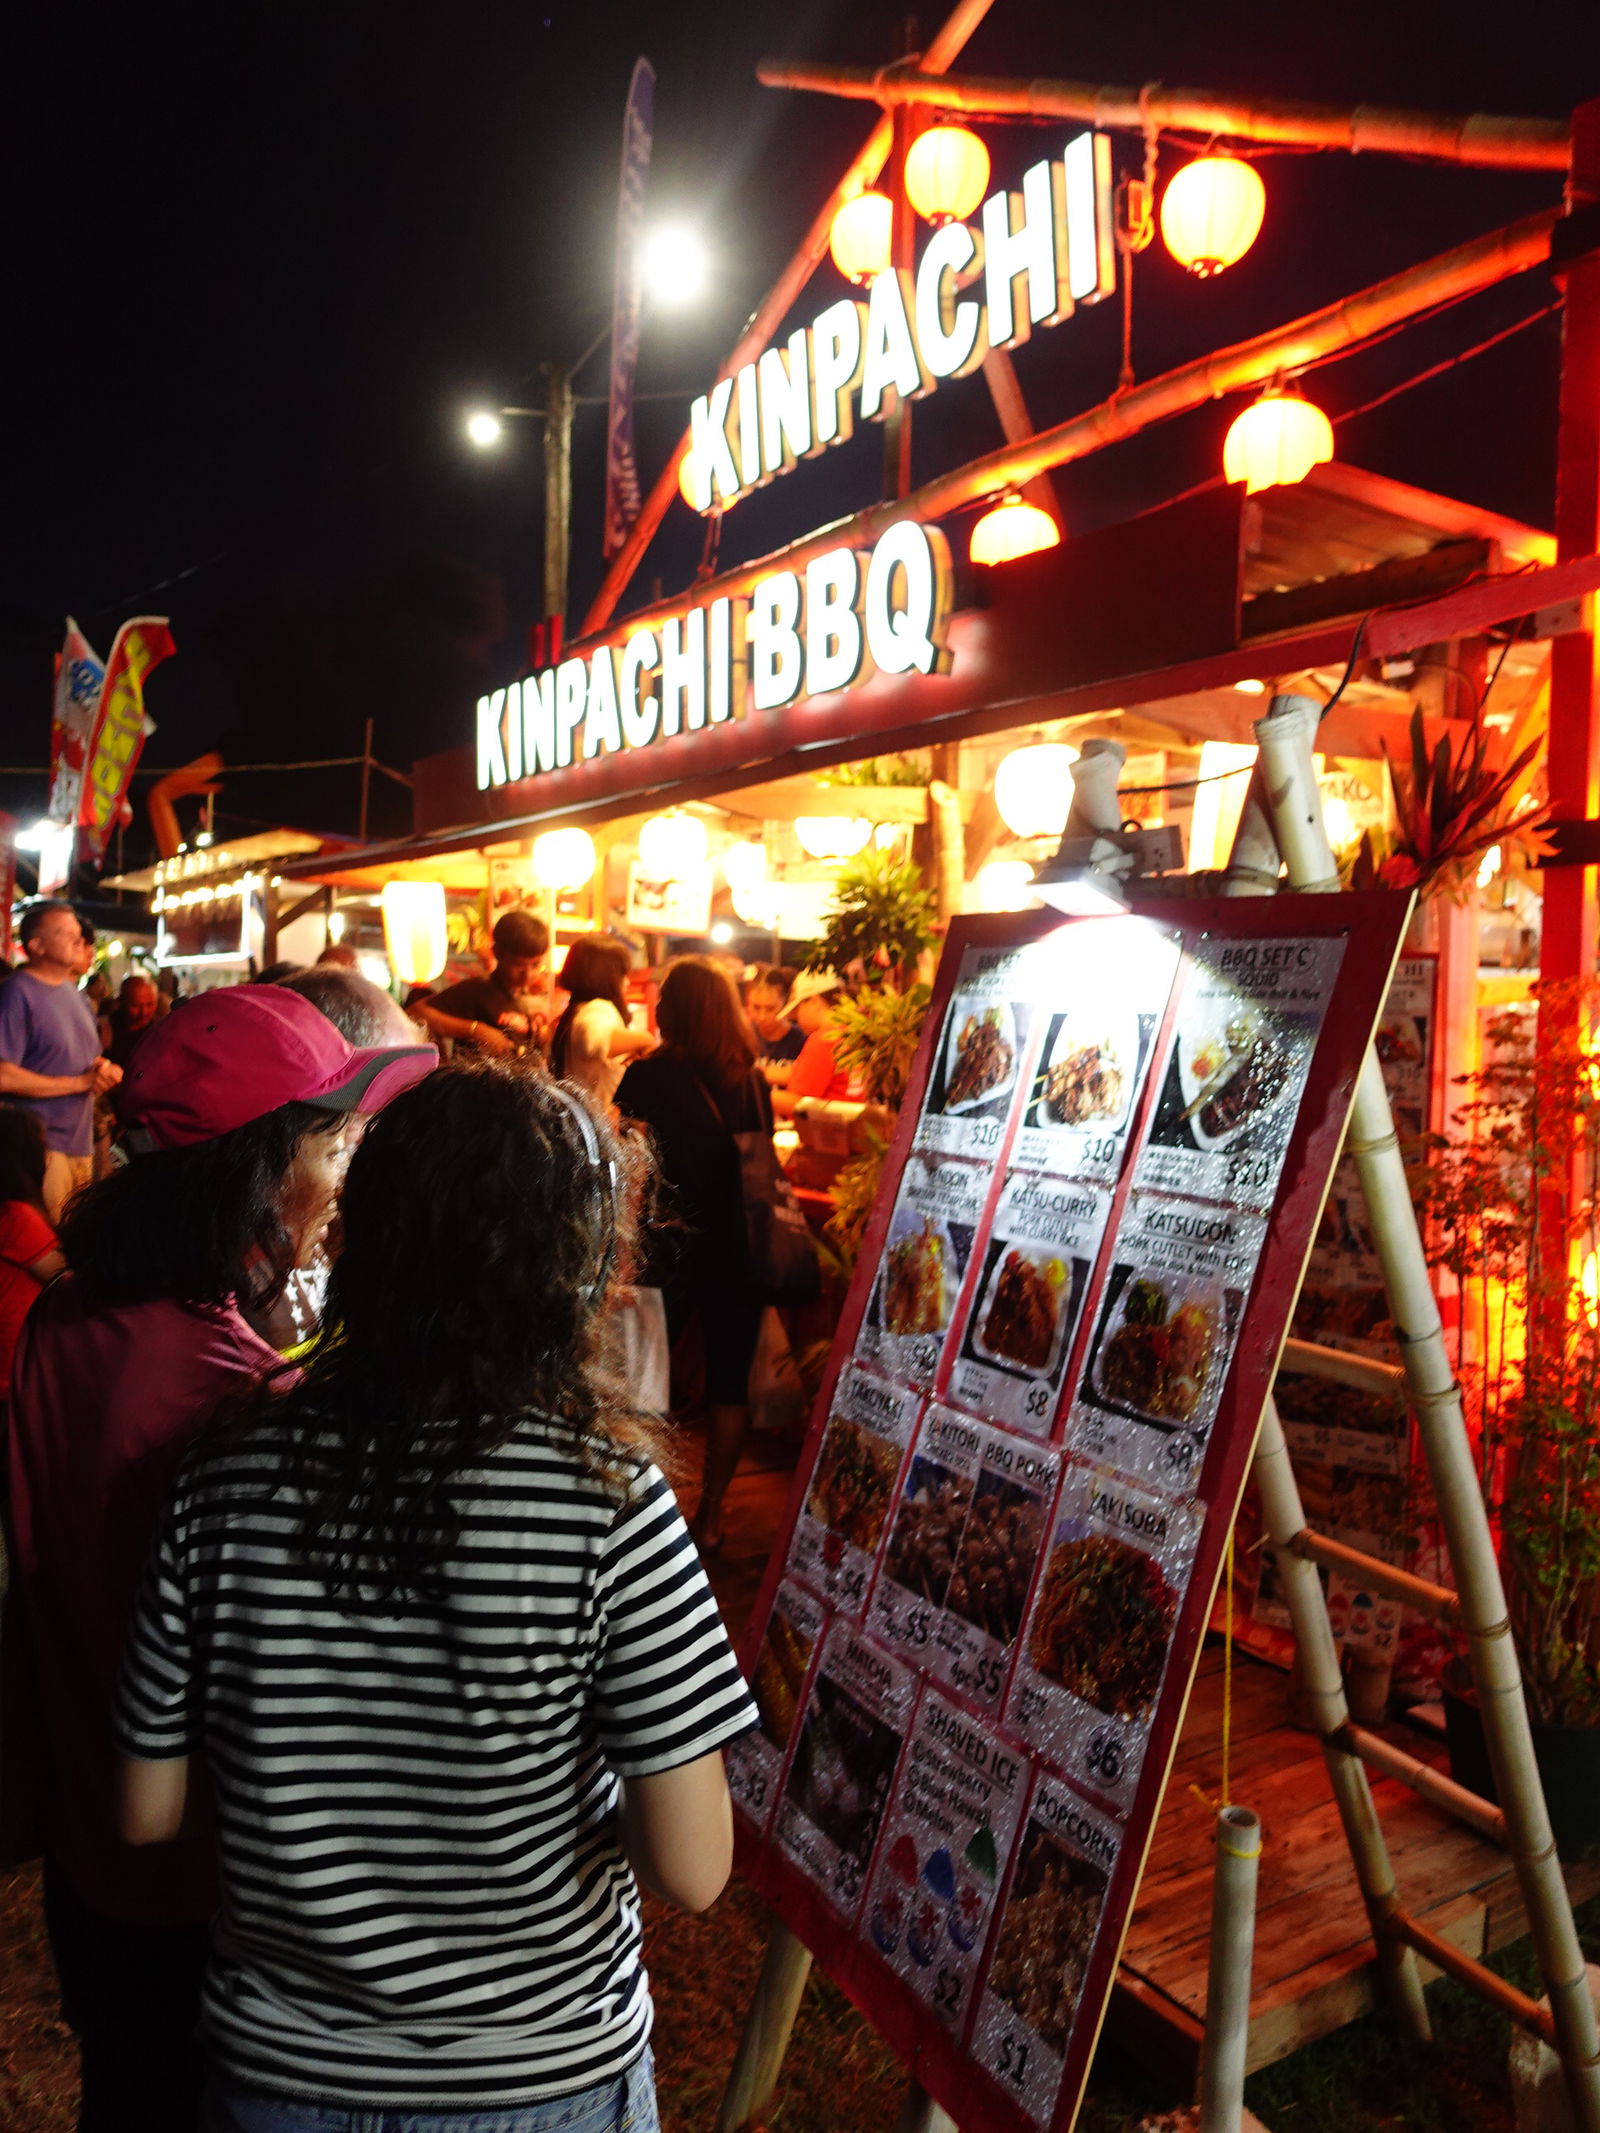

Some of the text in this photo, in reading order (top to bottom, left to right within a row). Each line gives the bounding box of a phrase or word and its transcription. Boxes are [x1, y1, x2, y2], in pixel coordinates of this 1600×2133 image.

[690, 131, 1112, 514] KINPACHI
[475, 519, 948, 791] KINPACHI BBQ
[1220, 945, 1312, 970] BBQ SET C
[970, 1121, 1001, 1146] $10
[1081, 1137, 1116, 1163] $10
[1009, 1186, 1098, 1220] KATSU-CURRY
[1144, 1208, 1239, 1245] KATSUDON
[1151, 1237, 1192, 1260] CUTLET
[1194, 1248, 1221, 1266] with
[1025, 1388, 1050, 1419] $8
[985, 1440, 1014, 1471] BBQ
[1086, 1487, 1168, 1540] YAKISOBA
[904, 1608, 931, 1645] $5
[974, 1656, 1004, 1696] $5
[925, 1703, 989, 1766] SHAVED
[990, 1749, 1020, 1789] ICE
[1035, 1786, 1118, 1863] POPCORN
[932, 1966, 963, 2017] $2
[997, 2031, 1031, 2086] $1
